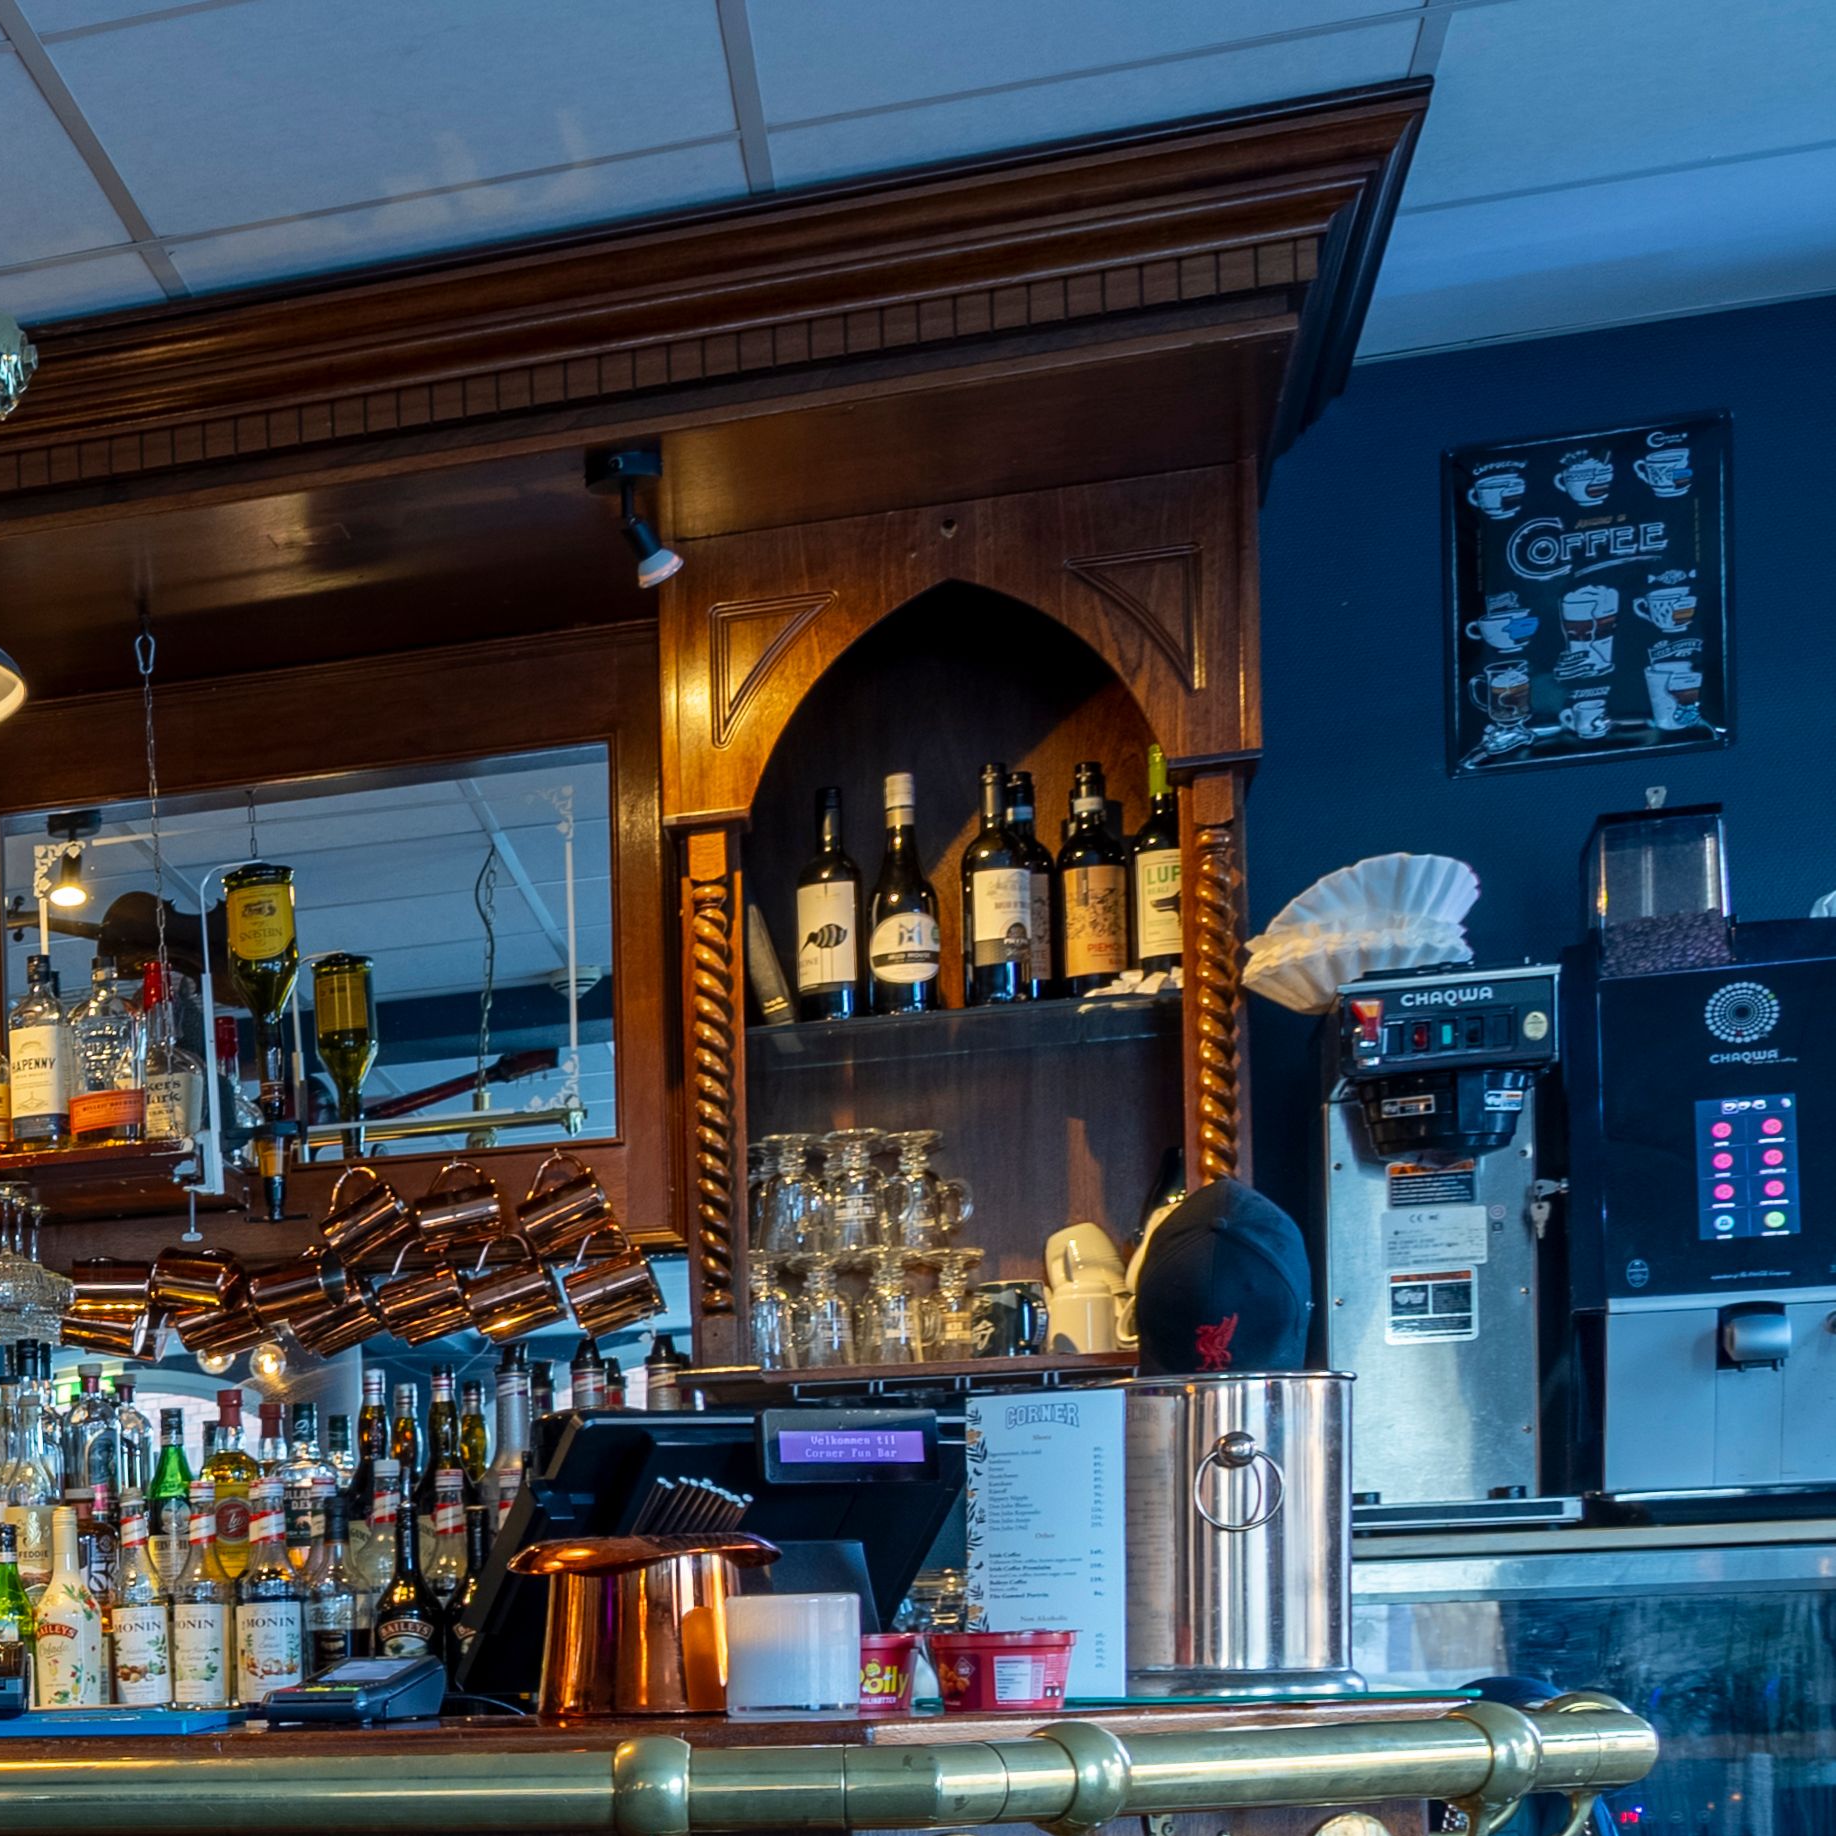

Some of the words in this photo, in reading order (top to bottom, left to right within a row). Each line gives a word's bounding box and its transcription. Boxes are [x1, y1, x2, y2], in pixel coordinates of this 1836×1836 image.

[1506, 516, 1669, 581] COFFEE
[1400, 985, 1495, 1008] CHAQWA
[1709, 1050, 1779, 1064] CHAQWA
[1004, 1402, 1080, 1430] CORNER
[811, 1435, 871, 1446] Velkommen
[876, 1435, 896, 1445] til
[805, 1449, 845, 1459] Corner
[850, 1449, 872, 1459] Fun
[878, 1448, 898, 1458] Bar
[18, 1549, 49, 1559] FEDDIE
[114, 1620, 162, 1634] MONIN
[245, 1616, 296, 1629] MONIN
[380, 1621, 429, 1637] BAILEYS
